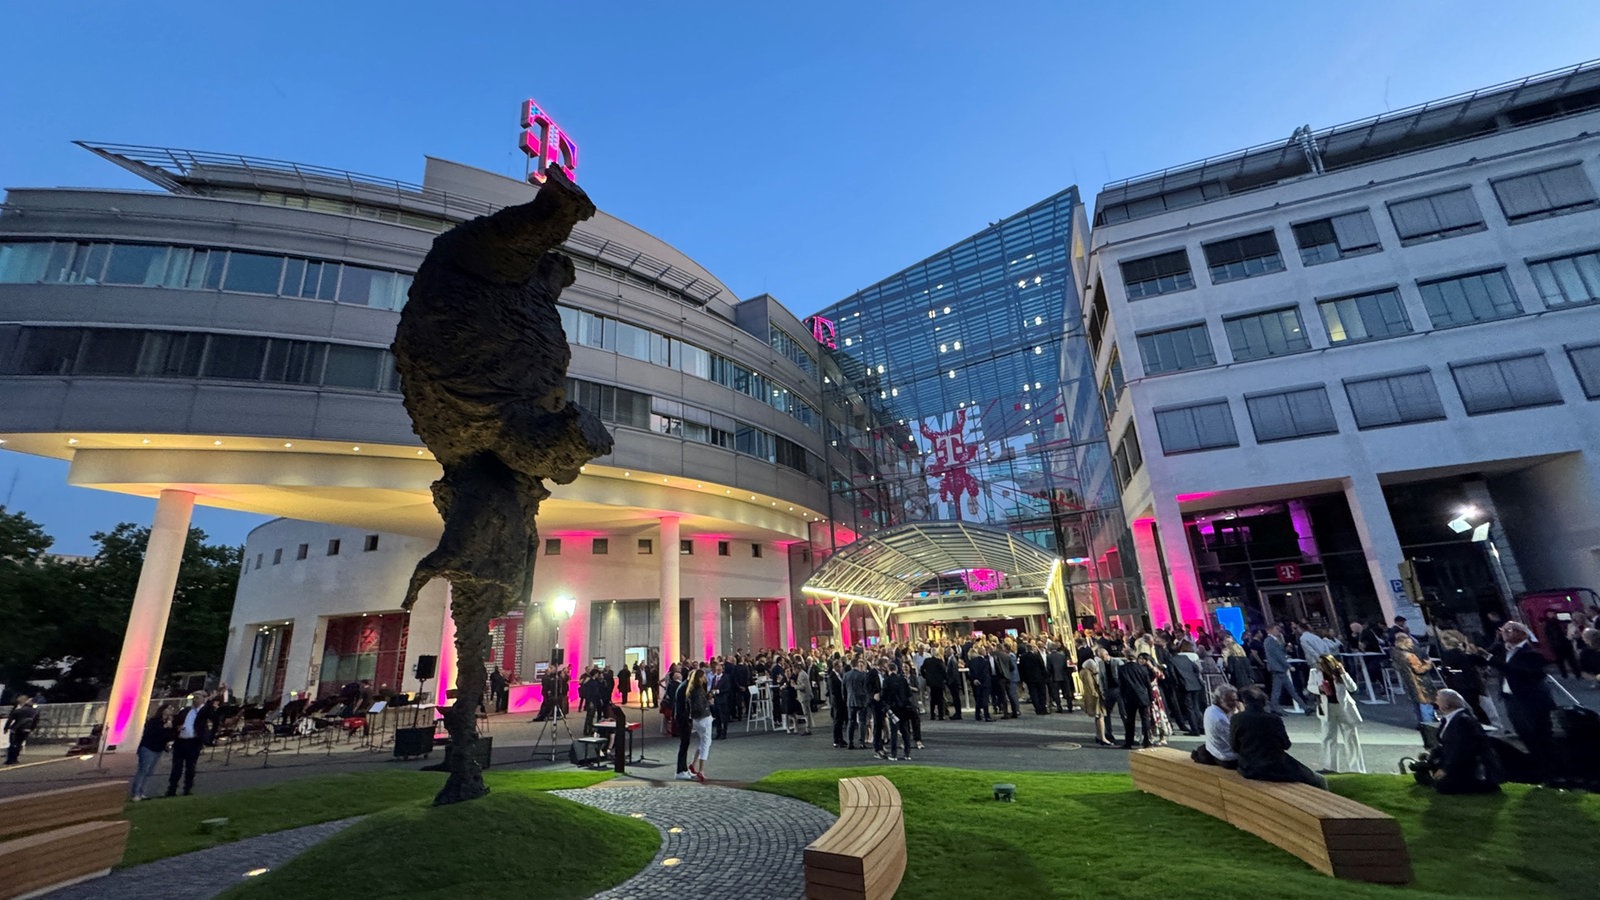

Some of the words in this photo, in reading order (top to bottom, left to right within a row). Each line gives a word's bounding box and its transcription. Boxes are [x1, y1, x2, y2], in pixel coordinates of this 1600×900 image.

[519, 99, 577, 184] T
[1280, 565, 1295, 579] T
[1393, 581, 1402, 591] P
